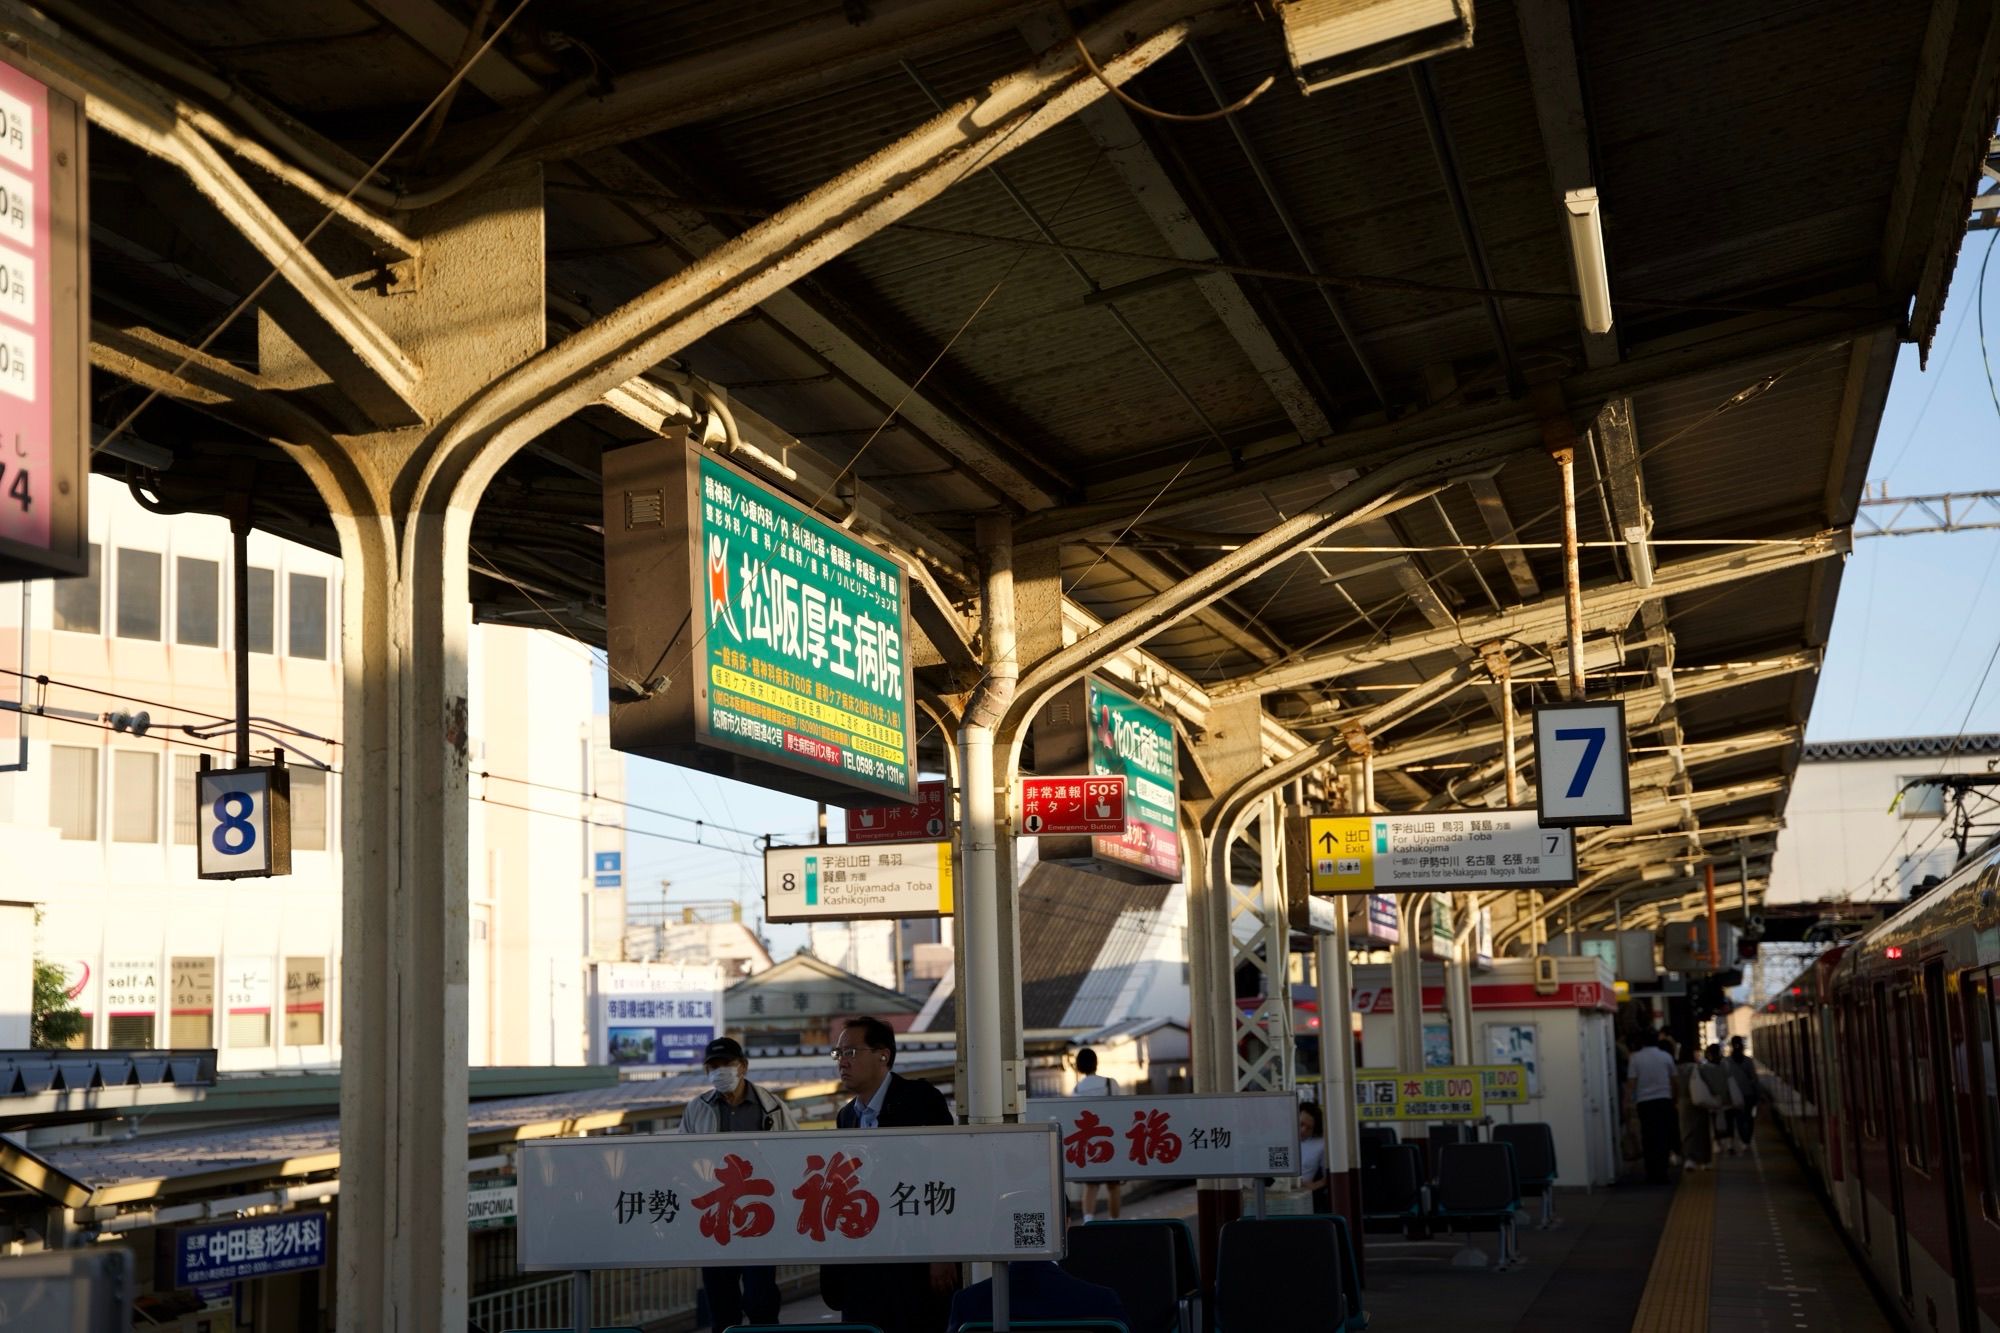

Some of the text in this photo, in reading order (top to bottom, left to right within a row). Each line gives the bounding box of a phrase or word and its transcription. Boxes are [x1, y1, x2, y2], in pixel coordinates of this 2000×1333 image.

[740, 551, 901, 702] 松阪厚生病院
[1555, 727, 1606, 798] 7
[1026, 786, 1080, 799] 非常通報
[1089, 784, 1118, 796] SOS
[1026, 801, 1080, 813] ボタン
[212, 791, 256, 855] 8
[1047, 824, 1089, 832] Emergency
[1392, 822, 1435, 834] 宇治山田
[1442, 821, 1463, 832] 鳥羽
[1470, 820, 1492, 831] 賢島
[1345, 829, 1370, 842] 出口
[1393, 833, 1493, 845] For Ujiyamada Toba
[1345, 843, 1365, 853] Exit
[1393, 844, 1450, 854] Kashikojima
[1546, 836, 1559, 854] 7
[823, 853, 903, 868] 宇治山田 鳥羽
[1419, 856, 1460, 868] 伊勢中川
[1465, 855, 1496, 866] 名古屋
[1502, 854, 1522, 866] 名張
[823, 871, 847, 883] 賢島
[1393, 870, 1411, 879] Some
[1412, 869, 1430, 878] trains
[1432, 869, 1442, 877] for
[1490, 867, 1516, 877] Nagoya
[1518, 866, 1541, 875] Nabari
[782, 872, 796, 891] 8
[823, 881, 933, 895] For Ujiyamada Toba
[823, 894, 885, 906] Kashikojima
[1497, 1070, 1518, 1086] DVD
[1403, 1080, 1421, 1097] 本
[1448, 1079, 1473, 1097] DVD
[1063, 1108, 1232, 1169] 赤福 名物
[616, 1150, 956, 1247] 伊勢 赤福 名物
[467, 1199, 513, 1219] SINFONIA
[208, 1218, 321, 1265] 中田整形外科
